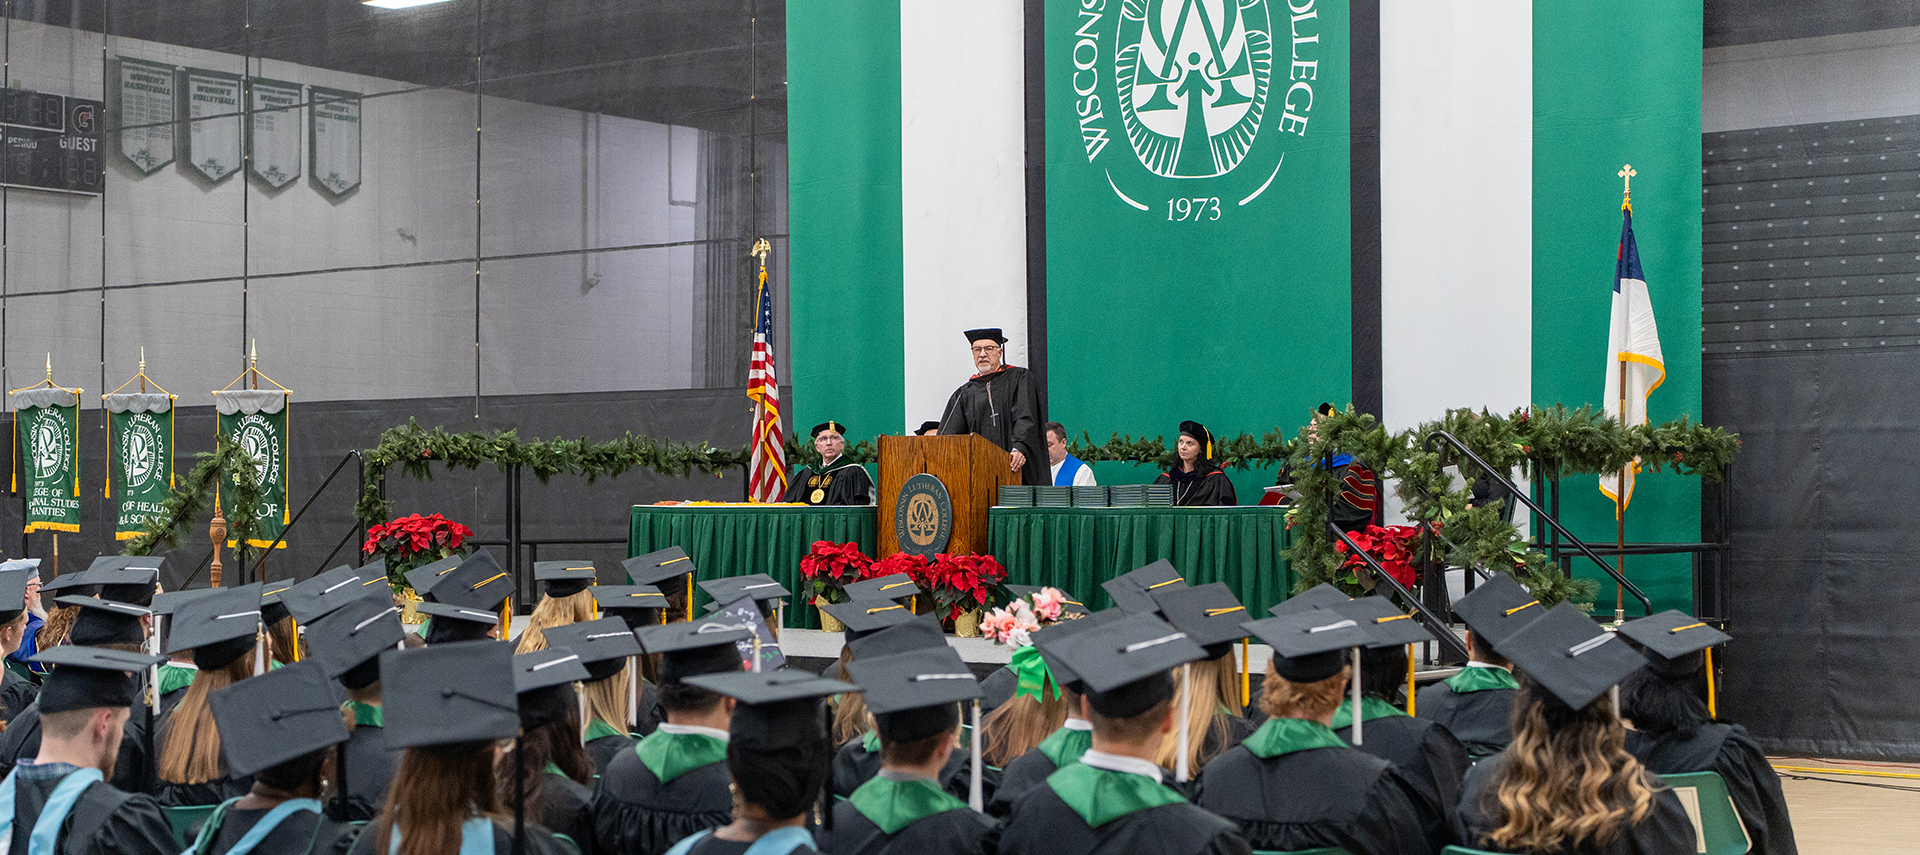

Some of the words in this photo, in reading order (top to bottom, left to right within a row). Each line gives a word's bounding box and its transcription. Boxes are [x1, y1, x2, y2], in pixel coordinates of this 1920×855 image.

[124, 81, 171, 96] BASKETBALL
[197, 85, 232, 96] WOMEN'S
[193, 93, 236, 105] VOLLEYBALL
[60, 135, 97, 152] GUEST
[1167, 197, 1221, 221] 1973
[154, 434, 164, 481] COLLEGE
[268, 435, 279, 485] COLLEGE
[51, 488, 63, 497] OF
[898, 492, 909, 539] WISCONSIN
[908, 482, 943, 500] LUTHERAN
[939, 501, 948, 540] COLLEGE
